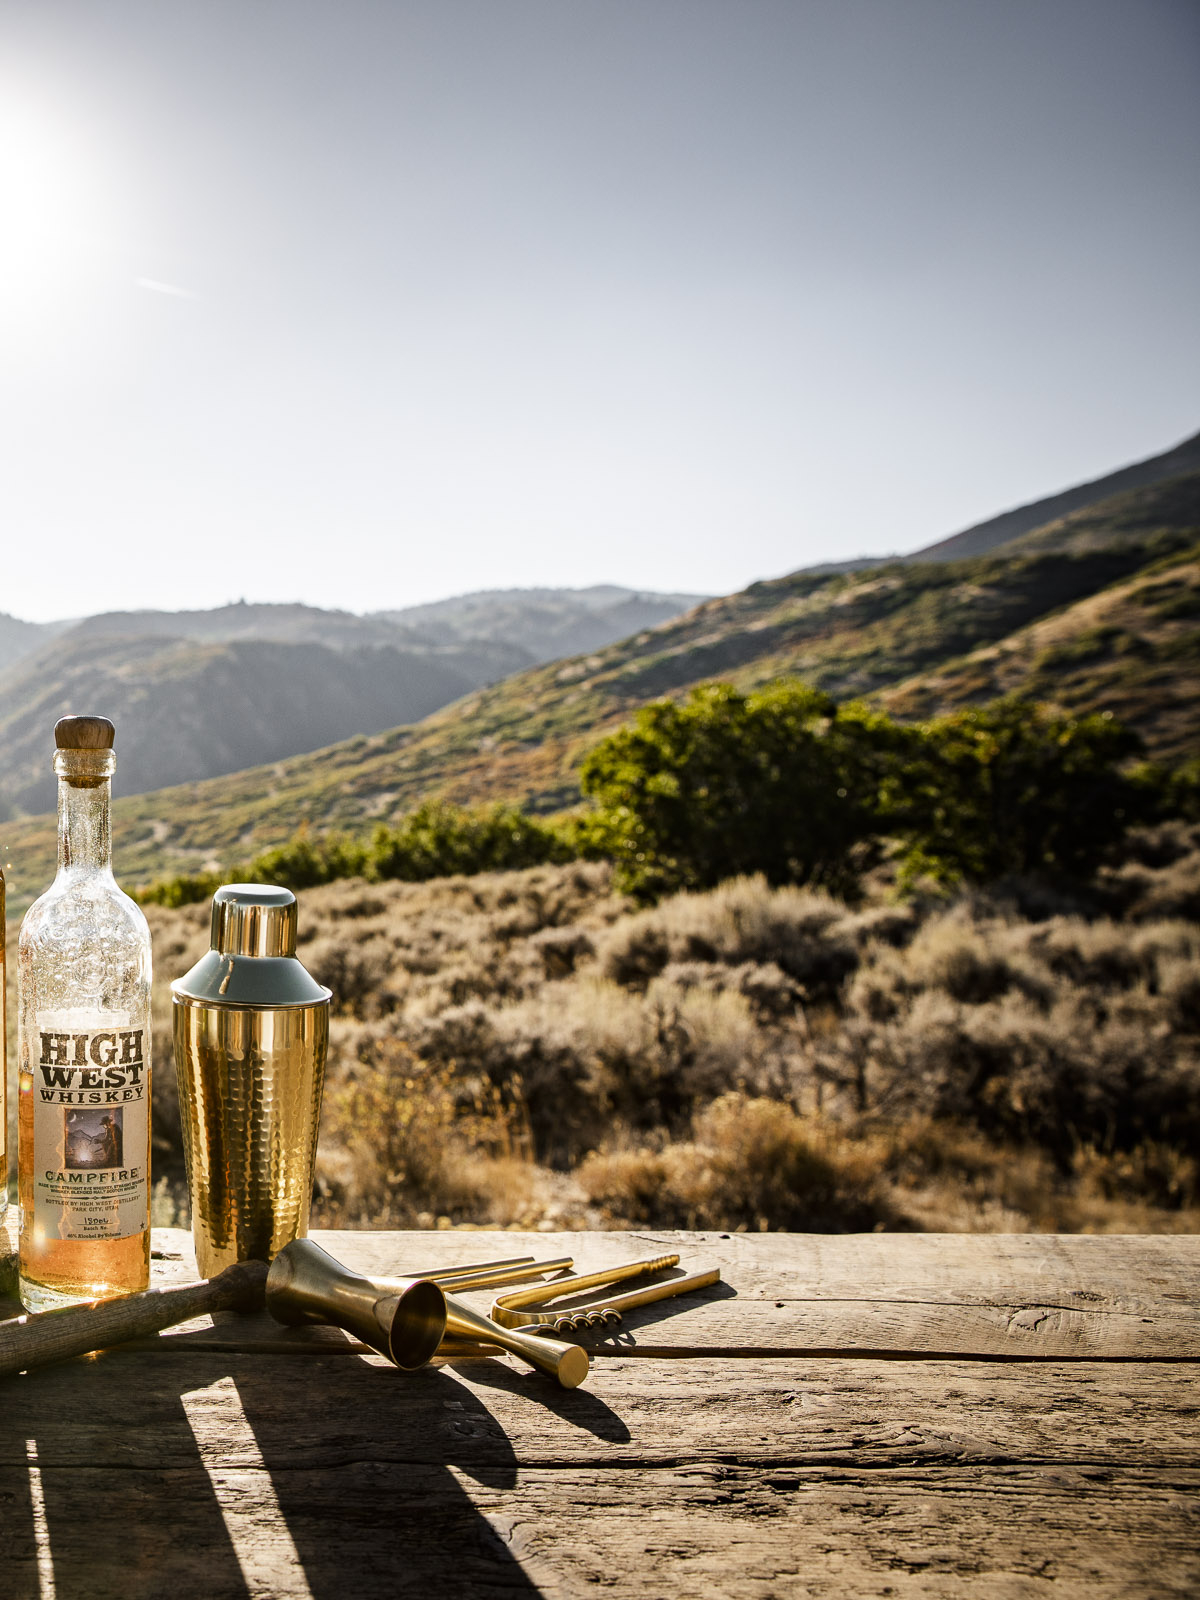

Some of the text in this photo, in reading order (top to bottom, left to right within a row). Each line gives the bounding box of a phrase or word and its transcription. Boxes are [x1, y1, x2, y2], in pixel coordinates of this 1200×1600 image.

[39, 1030, 144, 1067] HIGH
[39, 1062, 144, 1089] WEST
[40, 1086, 144, 1104] WHISKEY
[45, 1168, 138, 1183] CAMPFIRE
[45, 1198, 70, 1206] BOTTLED
